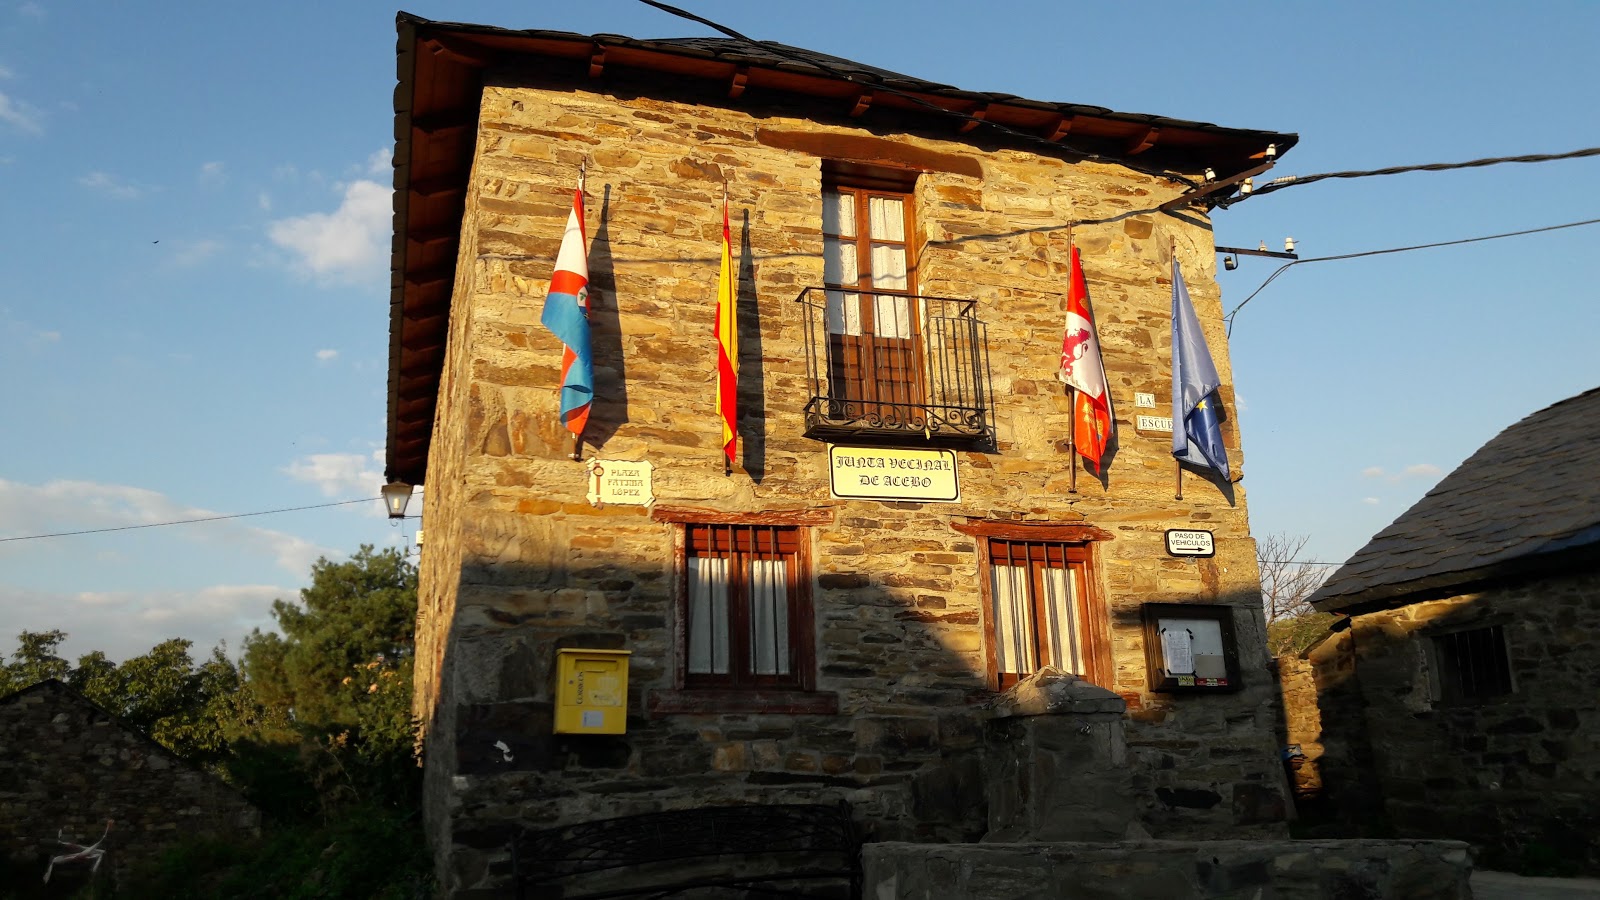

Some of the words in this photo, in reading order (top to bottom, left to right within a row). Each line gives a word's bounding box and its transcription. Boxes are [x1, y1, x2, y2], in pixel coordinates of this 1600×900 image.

[1139, 396, 1152, 405] LA
[1141, 418, 1173, 429] ESCUE
[836, 456, 885, 468] JUNTA
[889, 458, 951, 471] VECINAL
[611, 469, 640, 477] PLAZA
[859, 475, 879, 486] DE
[883, 476, 932, 488] ACEBO
